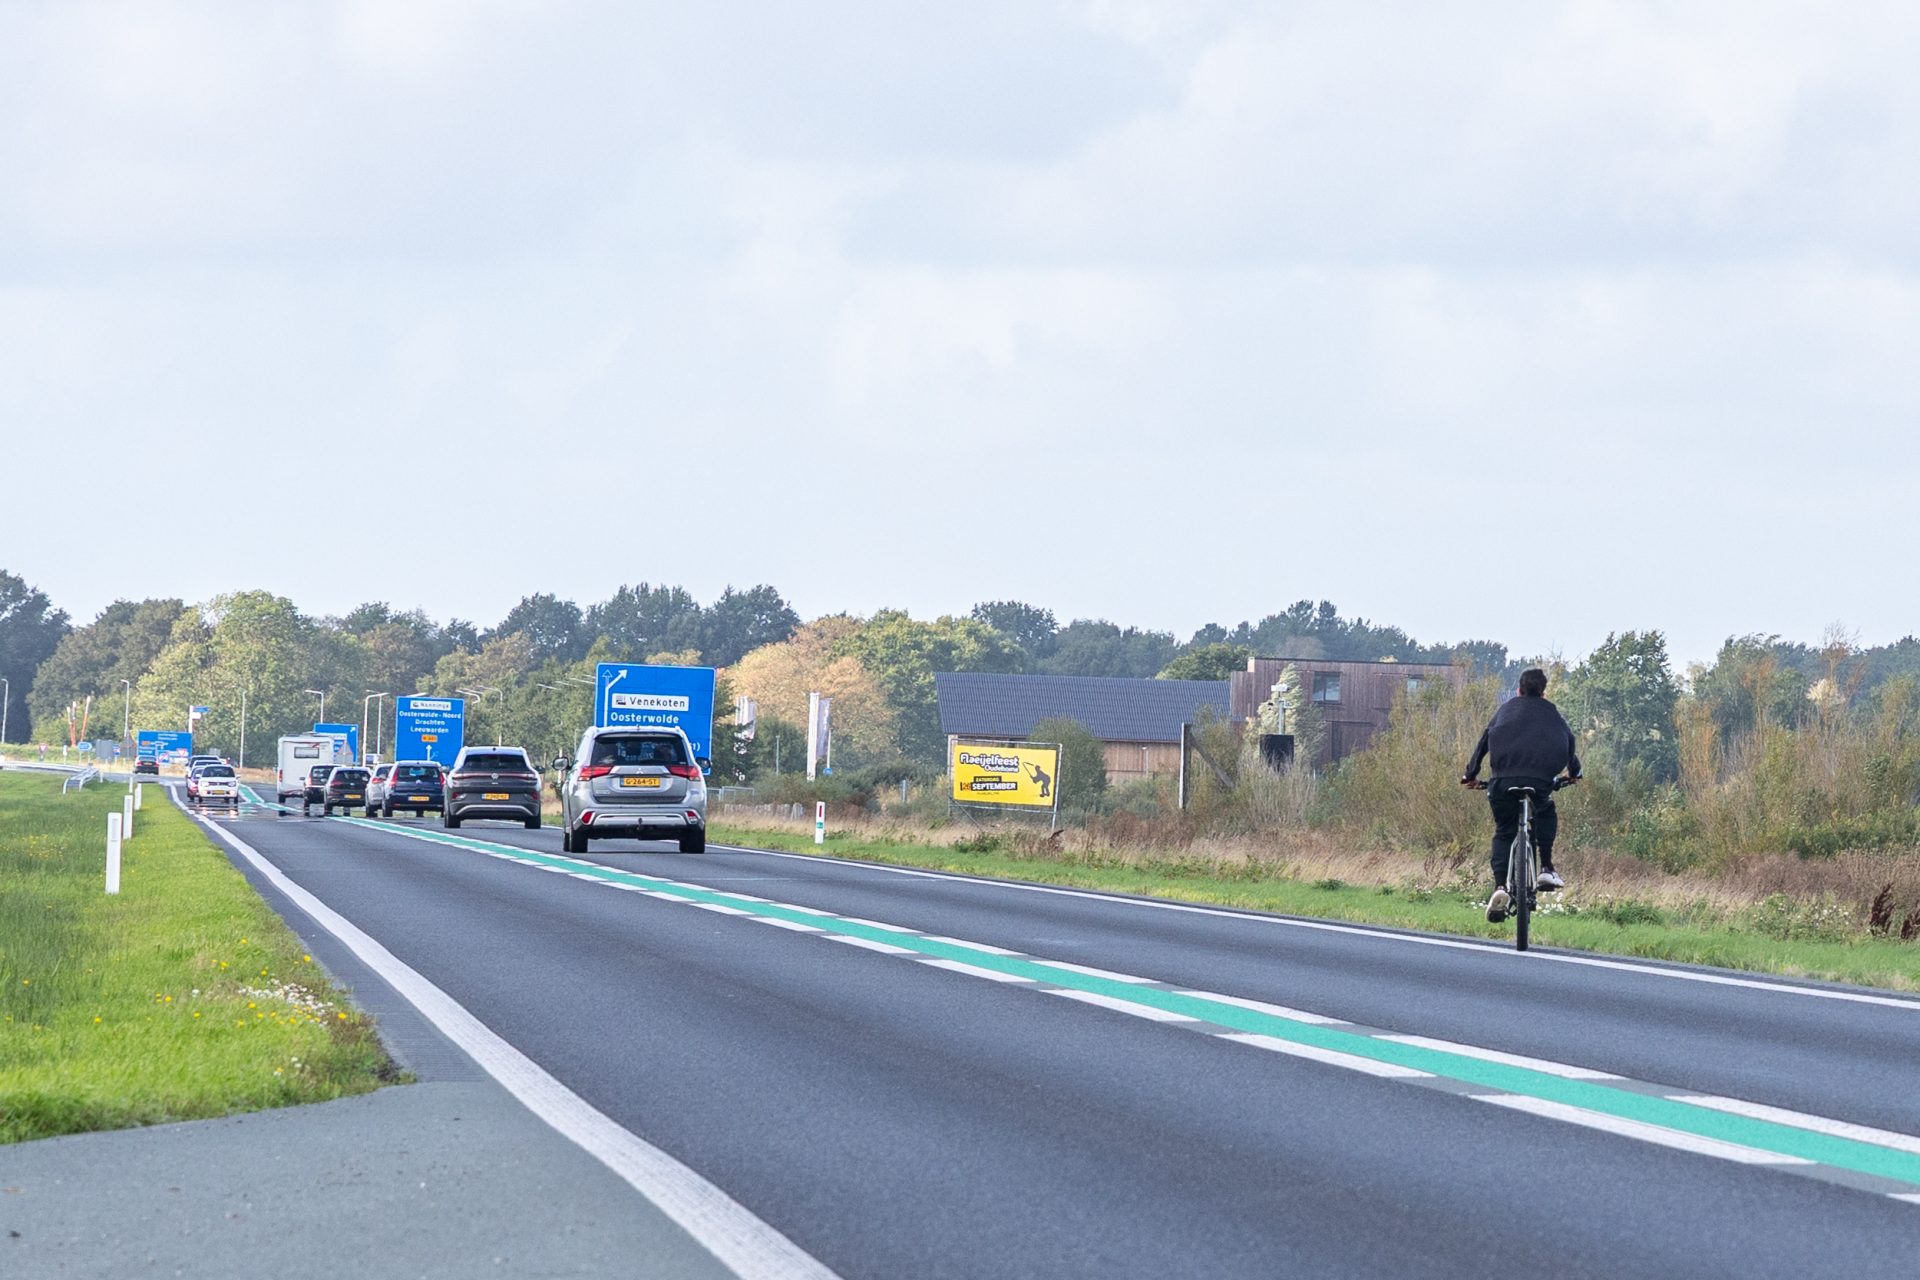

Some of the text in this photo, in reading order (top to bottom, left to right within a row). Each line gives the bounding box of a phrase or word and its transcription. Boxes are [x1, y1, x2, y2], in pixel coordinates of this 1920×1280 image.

[629, 696, 686, 708] Venekoten
[610, 711, 680, 724] Oosterwolde
[960, 752, 1019, 767] Flaeijelfeest
[972, 782, 1017, 790] SEPTEMBER
